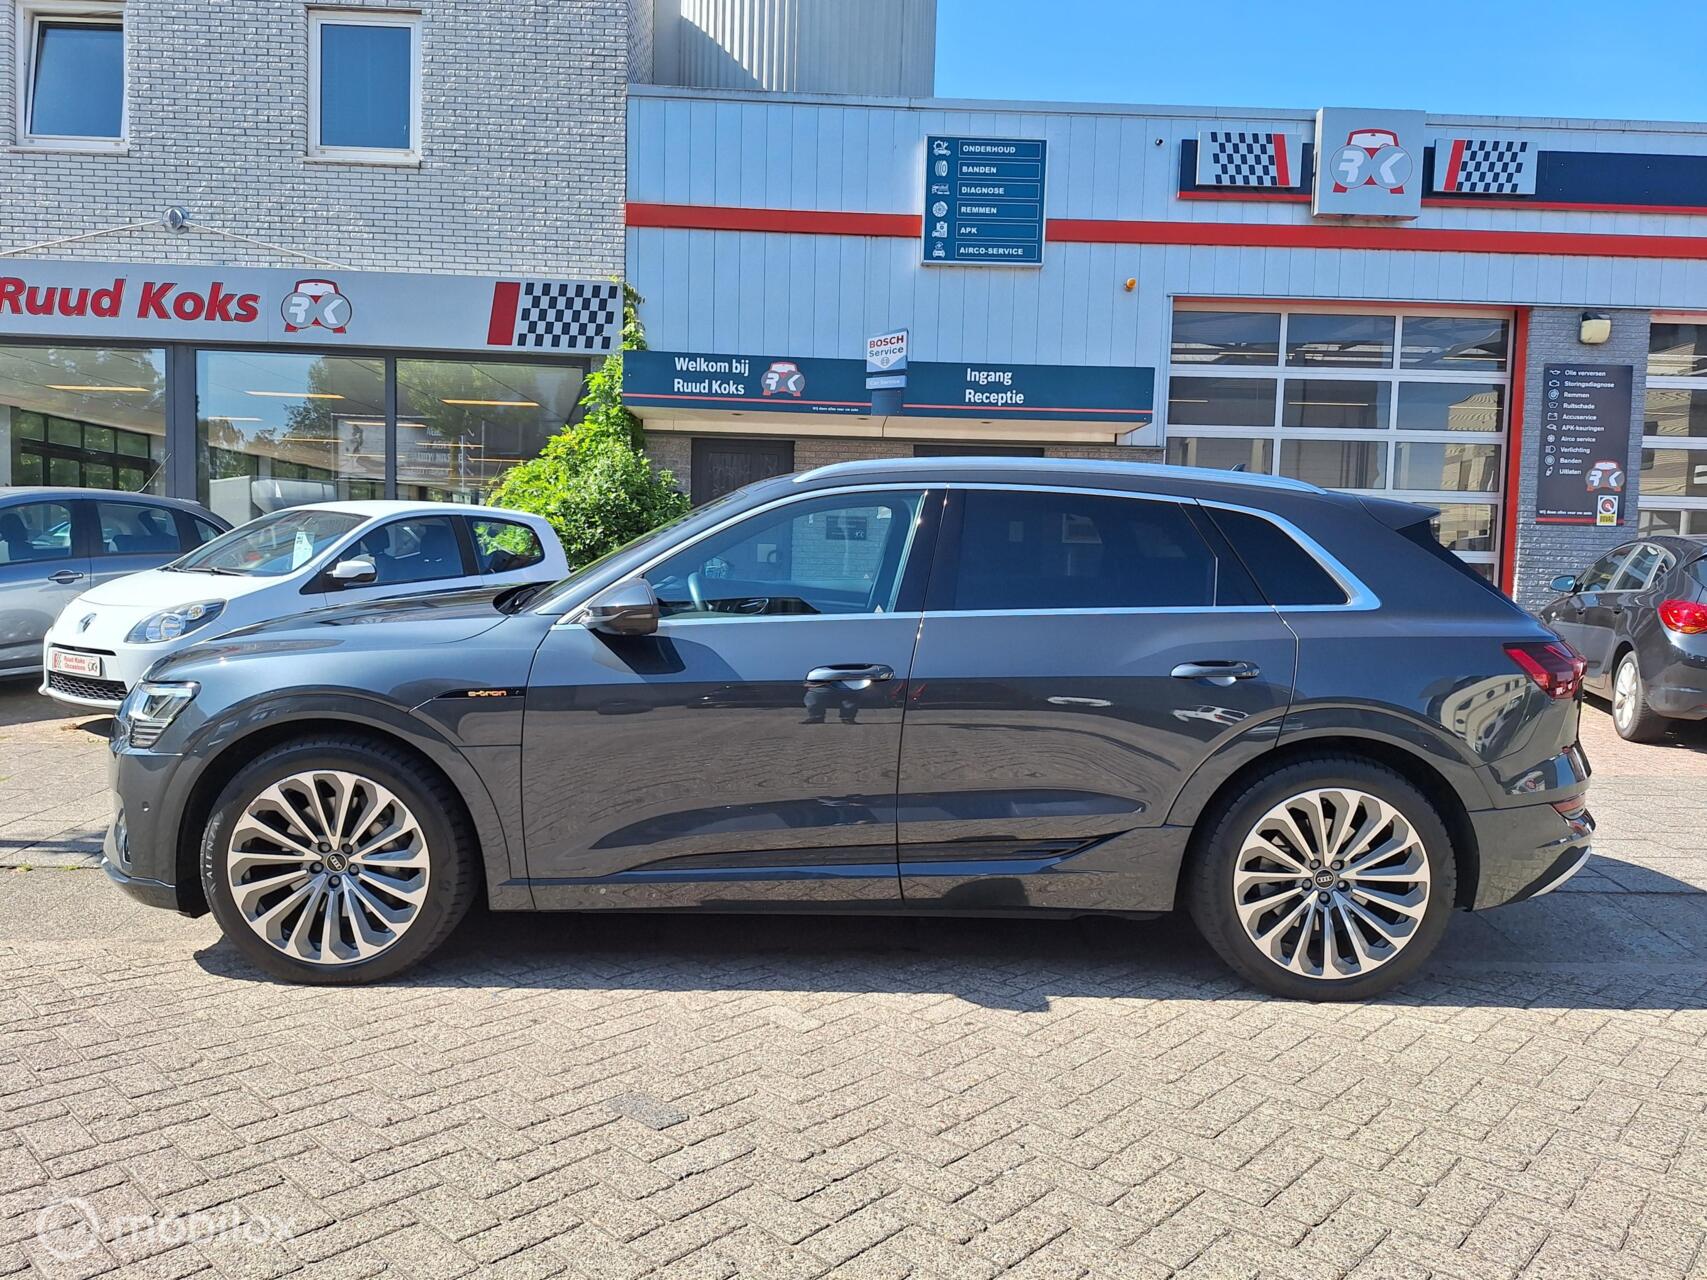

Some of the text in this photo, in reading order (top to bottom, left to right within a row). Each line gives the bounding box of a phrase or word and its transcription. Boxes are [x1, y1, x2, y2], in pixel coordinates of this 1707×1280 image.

[962, 145, 1016, 154] ONDERHOUD
[961, 165, 997, 174] BANDEN
[961, 186, 1005, 195] DIAGNOSE
[960, 206, 997, 214] REMMEN
[959, 247, 1024, 255] AIRCO-SERVICE
[0, 276, 261, 323] Ruud Koks
[869, 335, 904, 349] BOSCH
[869, 346, 904, 358] Service
[674, 357, 750, 377] Welkom bij
[966, 368, 1013, 386] Ingang
[673, 378, 745, 395] Ruud Koks
[1564, 380, 1615, 389] Storingsdiagnose
[965, 389, 1025, 407] Receptie
[1560, 446, 1590, 454] Verlichting
[205, 821, 220, 880] ALENZA
